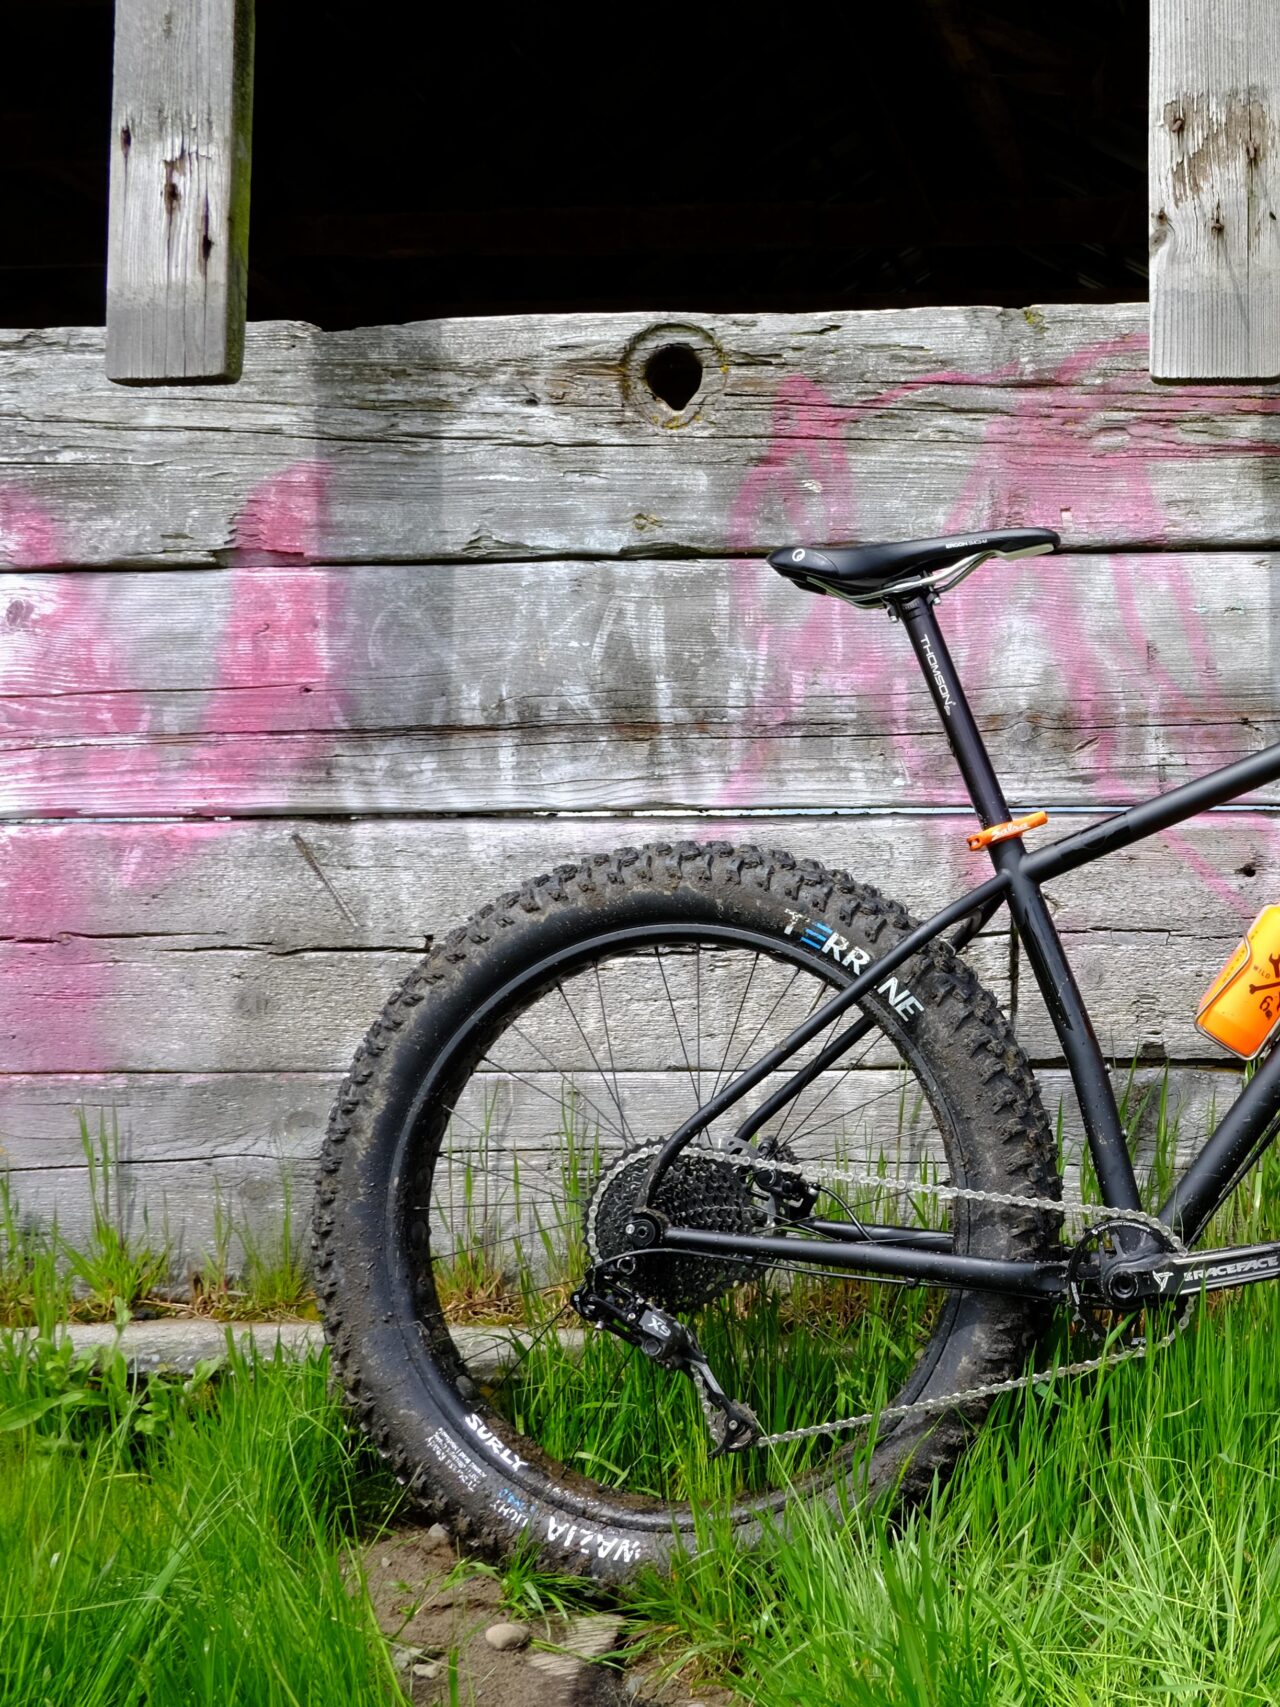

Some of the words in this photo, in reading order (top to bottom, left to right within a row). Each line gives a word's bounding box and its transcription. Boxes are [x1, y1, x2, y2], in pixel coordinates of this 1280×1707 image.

[920, 633, 953, 706] THOMSON
[783, 907, 925, 1023] TERRNE
[425, 1435, 447, 1461] Ready
[464, 1413, 529, 1472] SURLY
